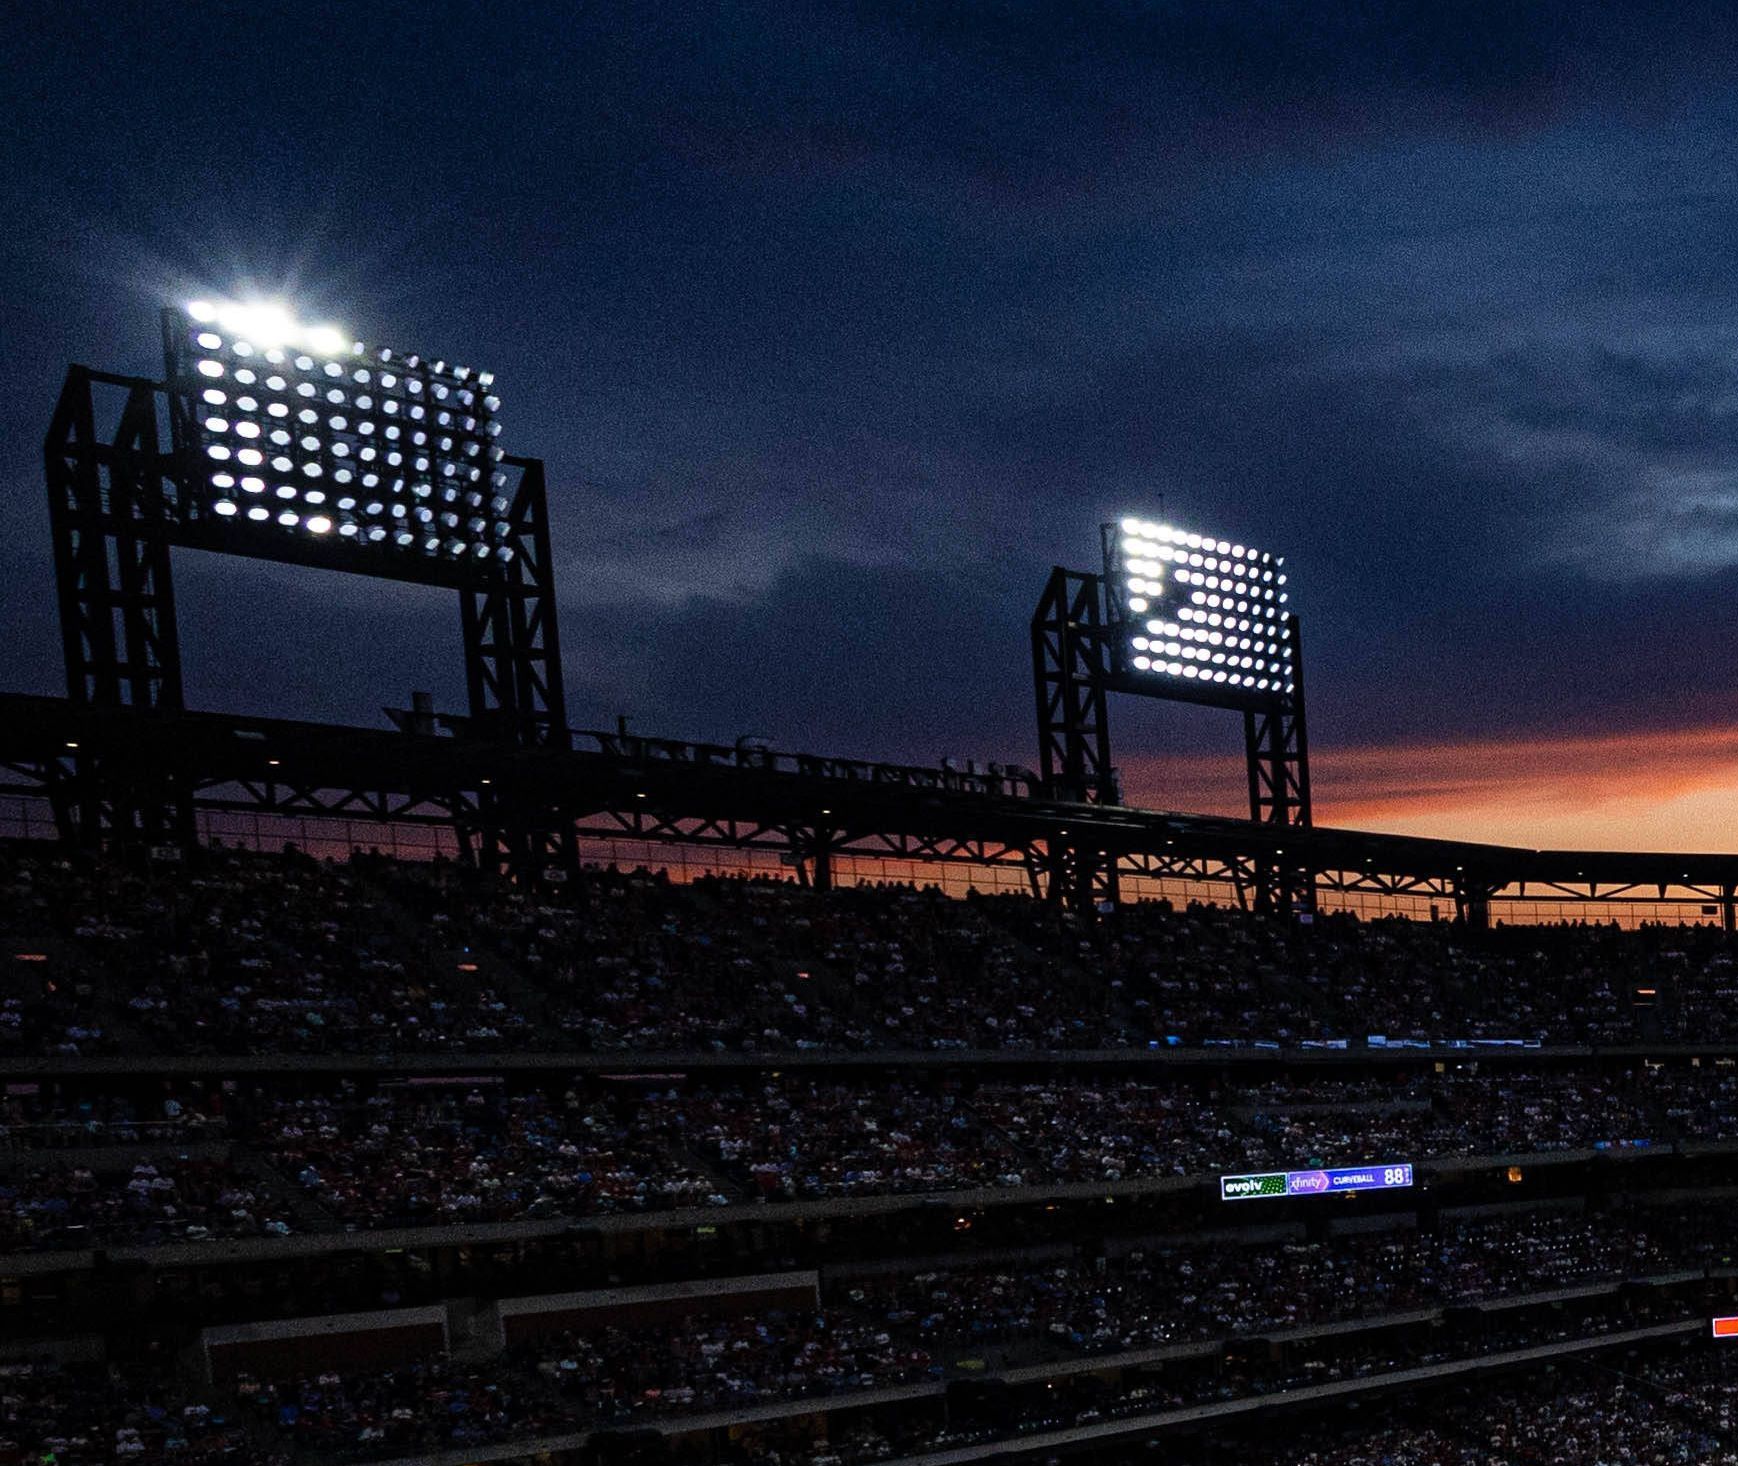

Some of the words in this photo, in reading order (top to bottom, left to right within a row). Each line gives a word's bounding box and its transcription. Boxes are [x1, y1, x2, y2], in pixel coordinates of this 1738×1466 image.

[1333, 1175, 1374, 1185] CURVEBALL
[1384, 1168, 1403, 1185] 88
[1225, 1180, 1264, 1194] evolv
